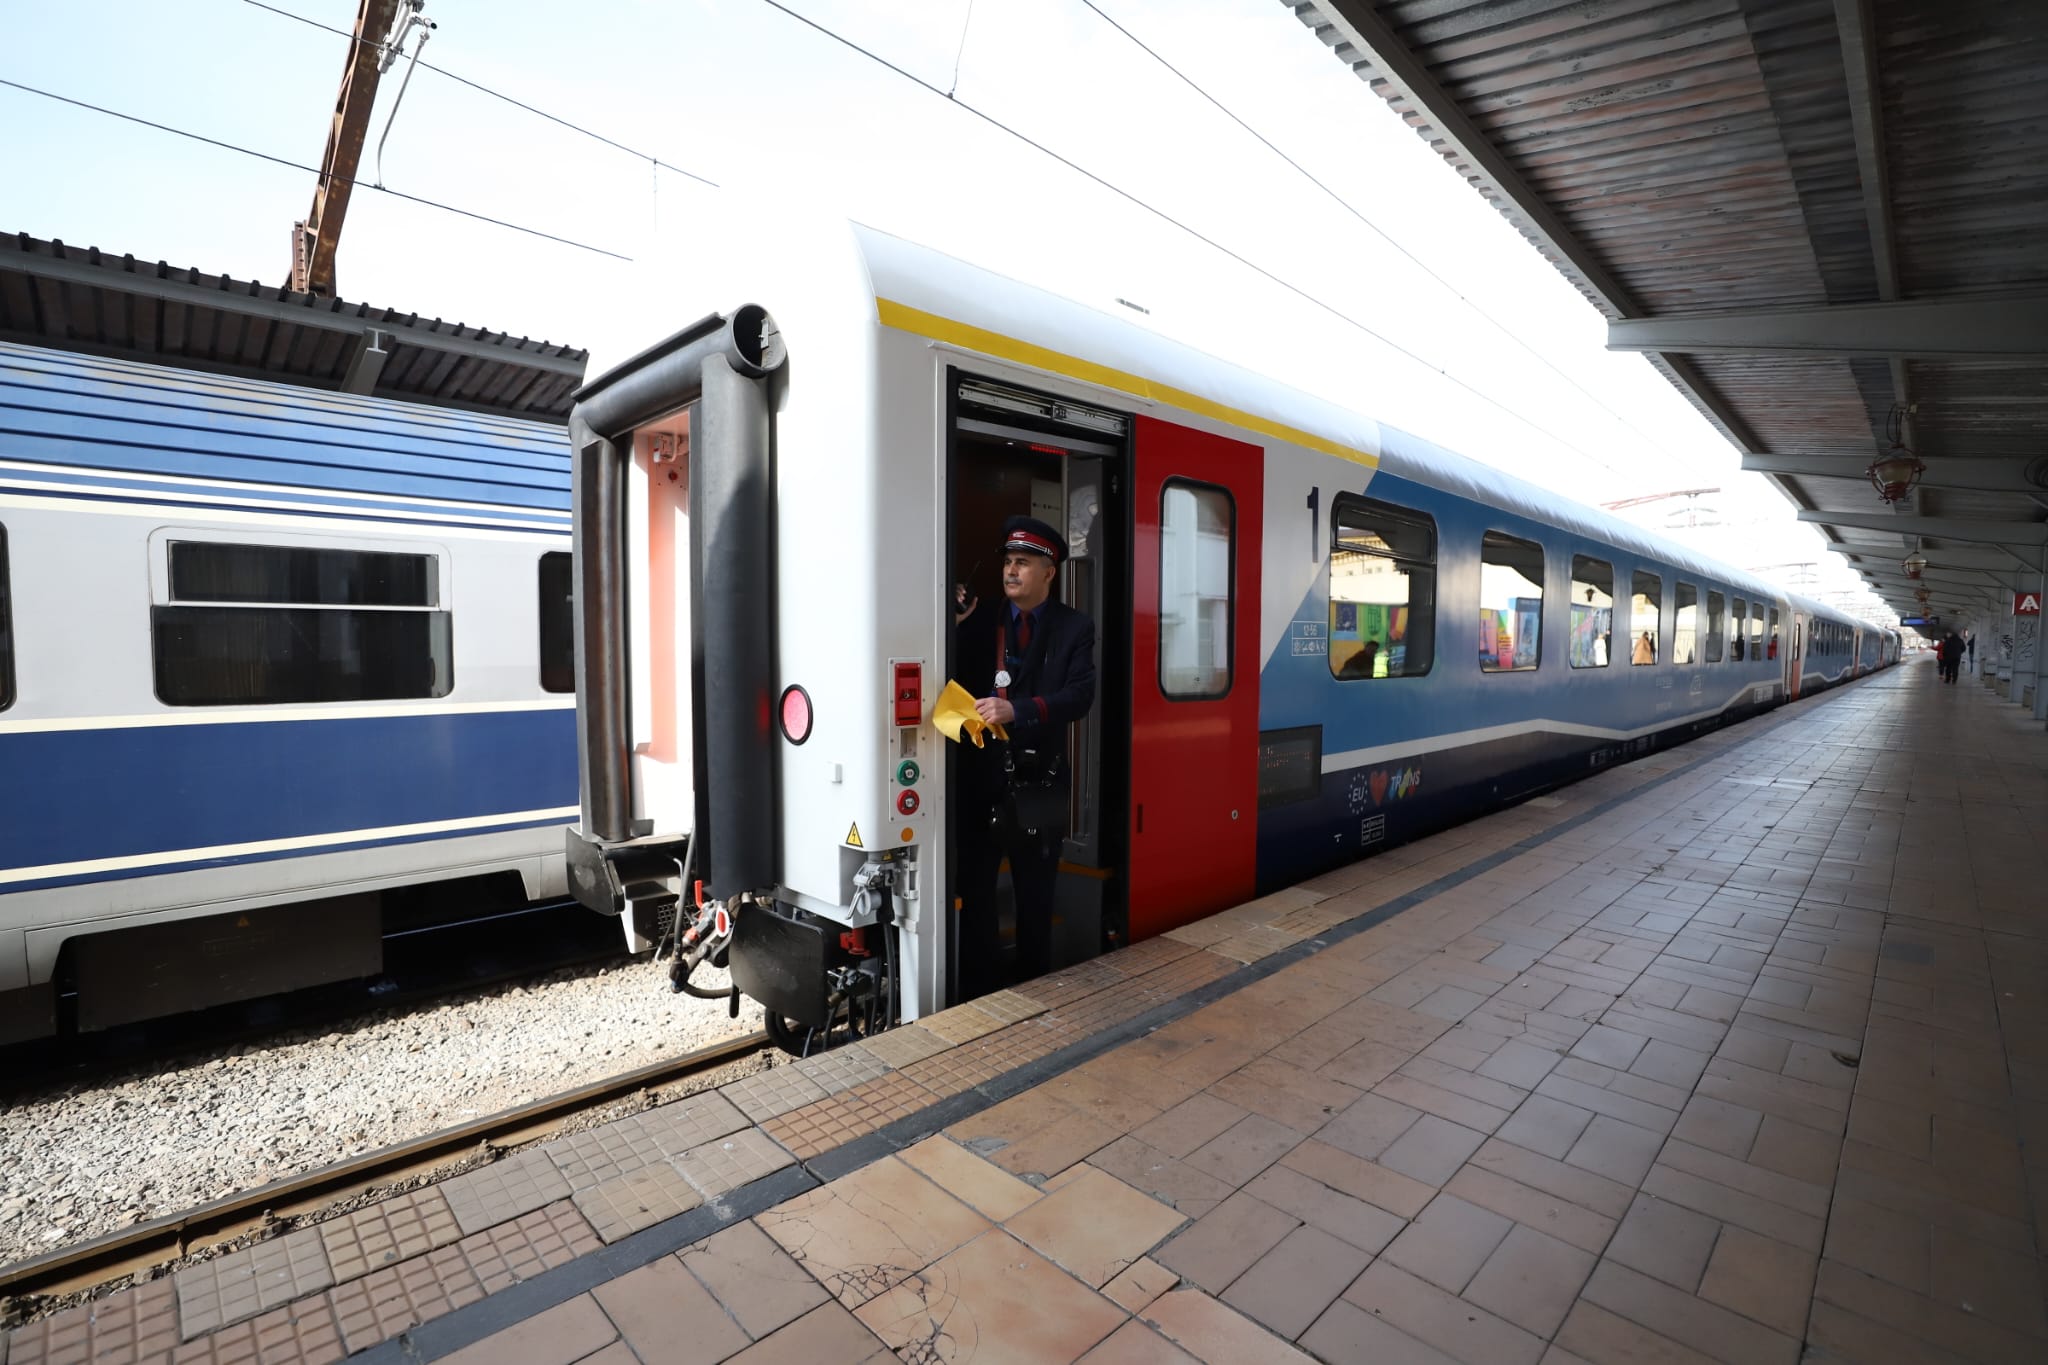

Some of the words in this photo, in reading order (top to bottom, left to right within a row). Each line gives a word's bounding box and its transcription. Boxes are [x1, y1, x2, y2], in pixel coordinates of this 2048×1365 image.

[1307, 486, 1319, 563] 1
[2019, 594, 2040, 610] A
[1352, 786, 1365, 802] EU
[1391, 769, 1421, 791] TRANS
